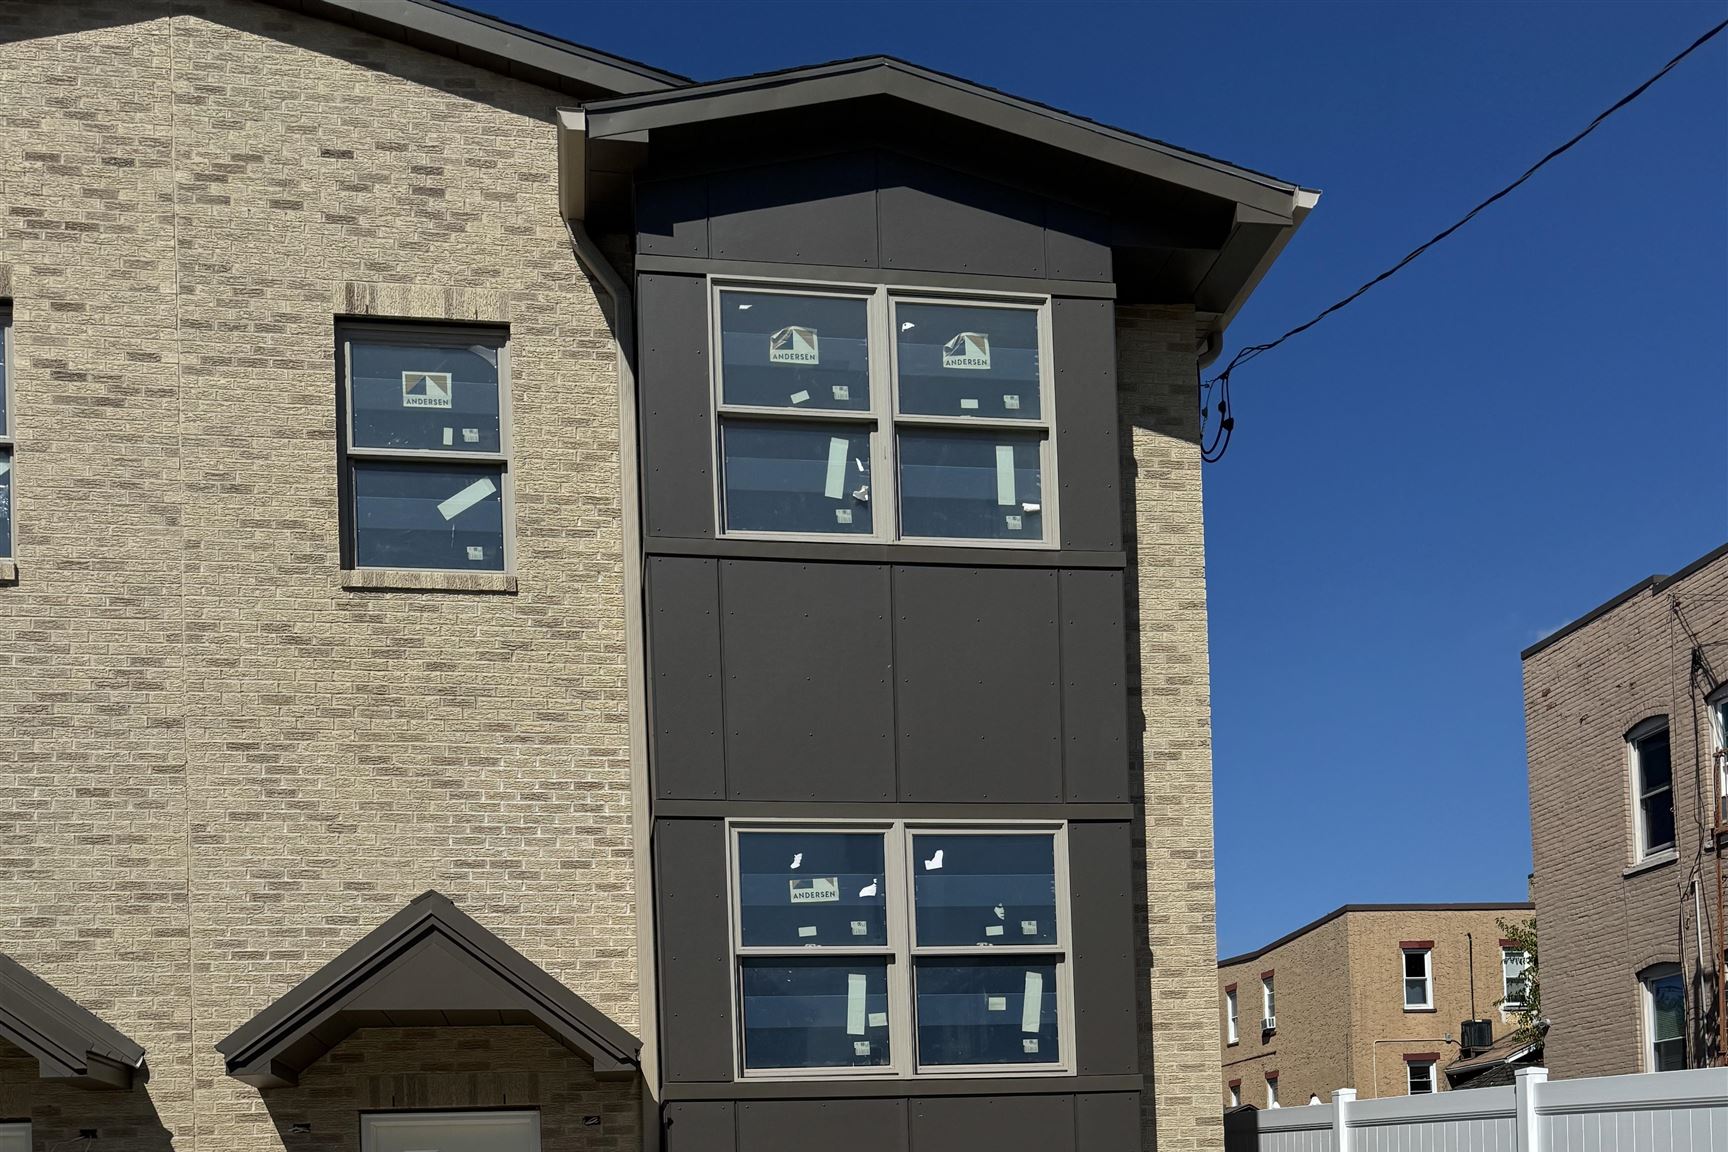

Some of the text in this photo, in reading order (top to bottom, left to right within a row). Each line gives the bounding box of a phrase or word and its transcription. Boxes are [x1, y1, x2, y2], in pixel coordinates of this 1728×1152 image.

[772, 353, 816, 361] ANDERSEN
[945, 359, 988, 367] ANDERSEN
[406, 398, 449, 406] ANDERSEN
[793, 890, 836, 899] ANDERSEN
